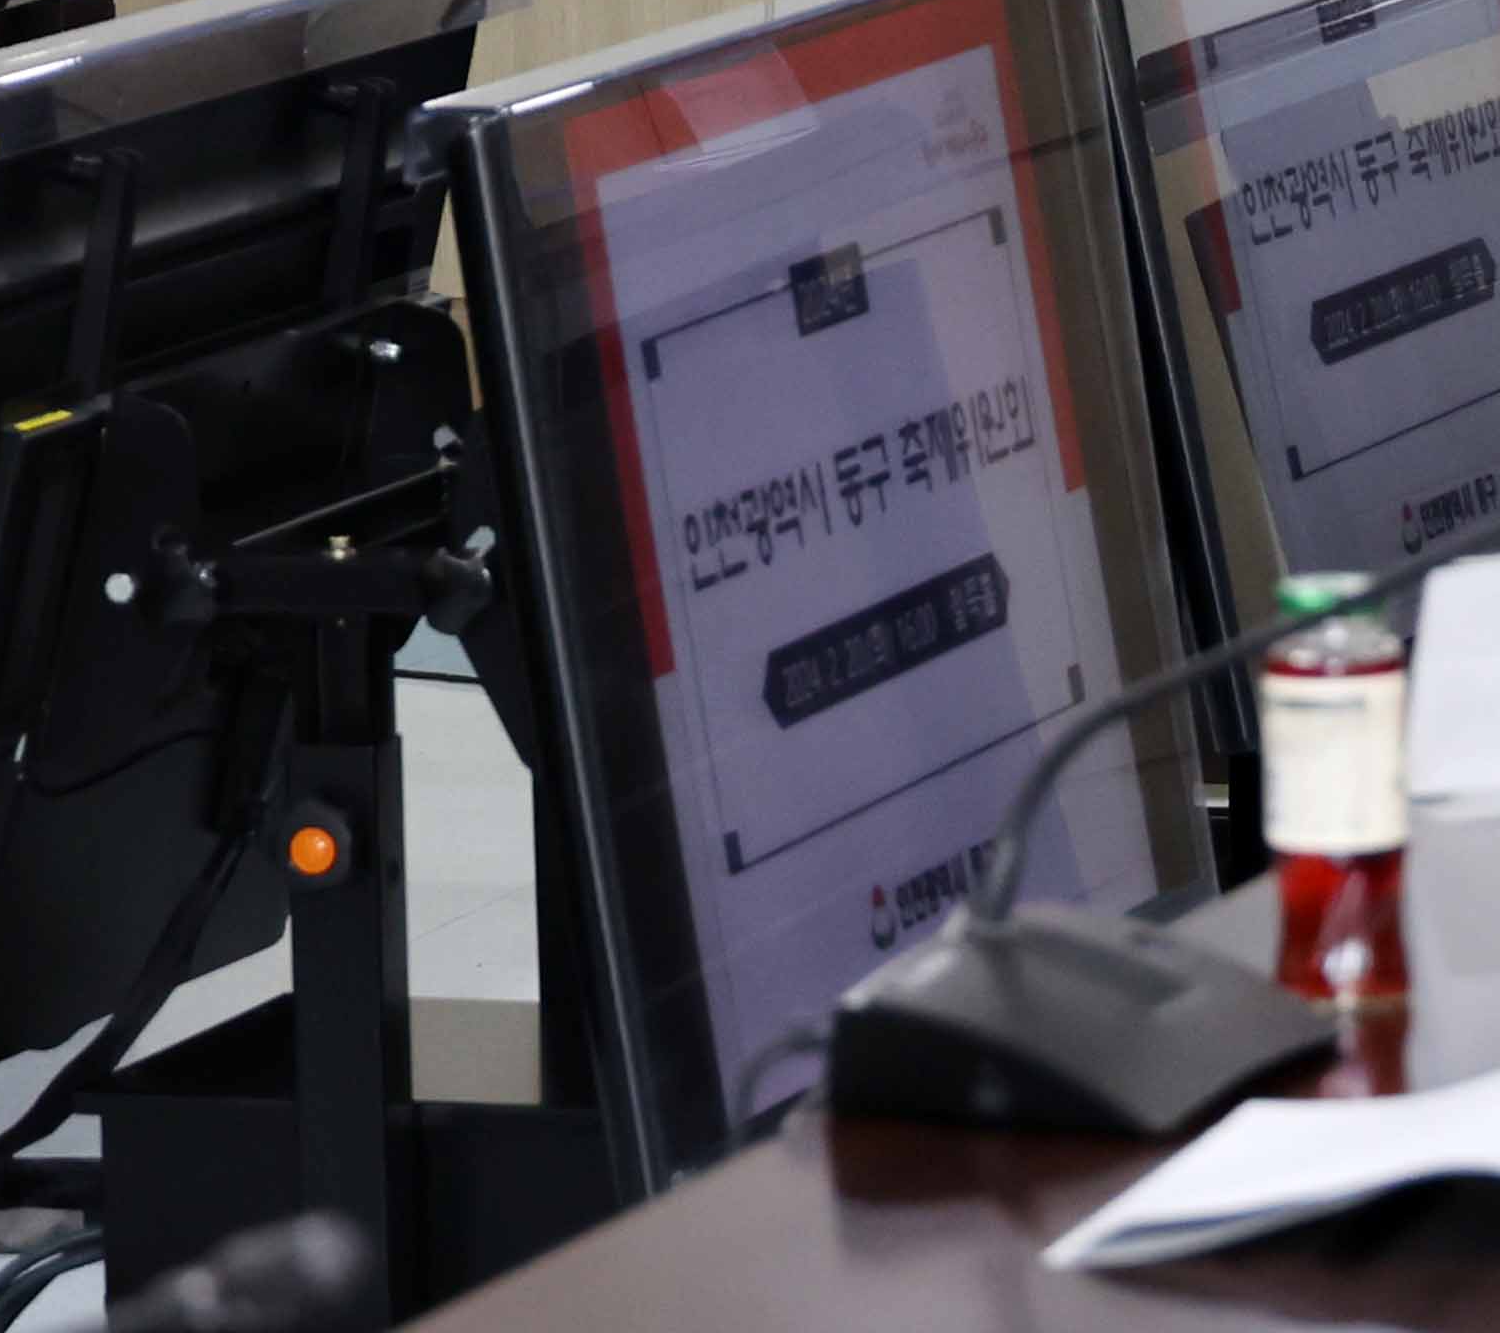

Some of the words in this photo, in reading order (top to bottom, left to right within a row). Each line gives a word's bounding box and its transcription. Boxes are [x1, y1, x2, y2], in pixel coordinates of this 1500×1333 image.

[1241, 164, 1354, 246] 인천광역시
[1356, 130, 1402, 205] 동구
[683, 458, 830, 593] 인천광역시
[835, 440, 893, 531] 동구
